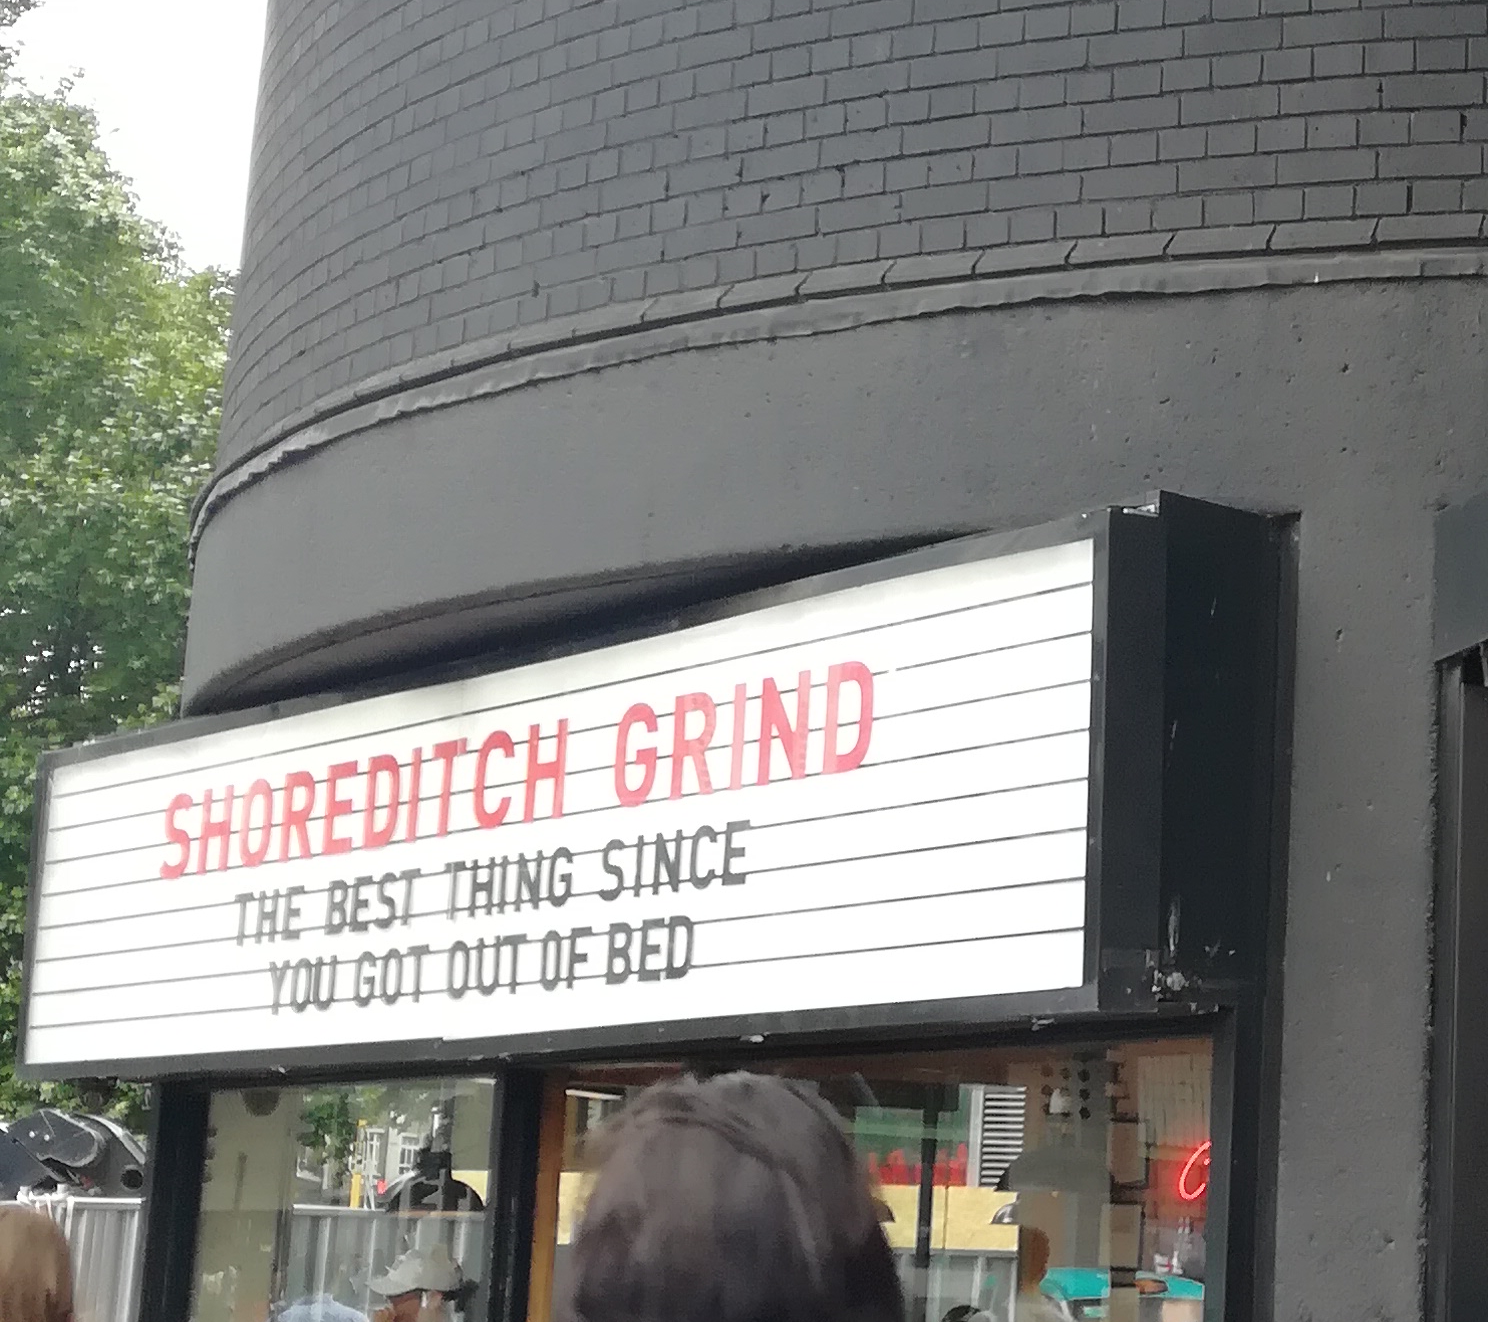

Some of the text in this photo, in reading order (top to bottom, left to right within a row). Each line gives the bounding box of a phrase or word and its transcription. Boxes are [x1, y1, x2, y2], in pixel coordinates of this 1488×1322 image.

[159, 660, 875, 880] SHOREDITCH GRIND
[233, 820, 752, 947] THE BEST THING SINCE
[269, 916, 694, 1015] YOU GOT OUT OF BED
